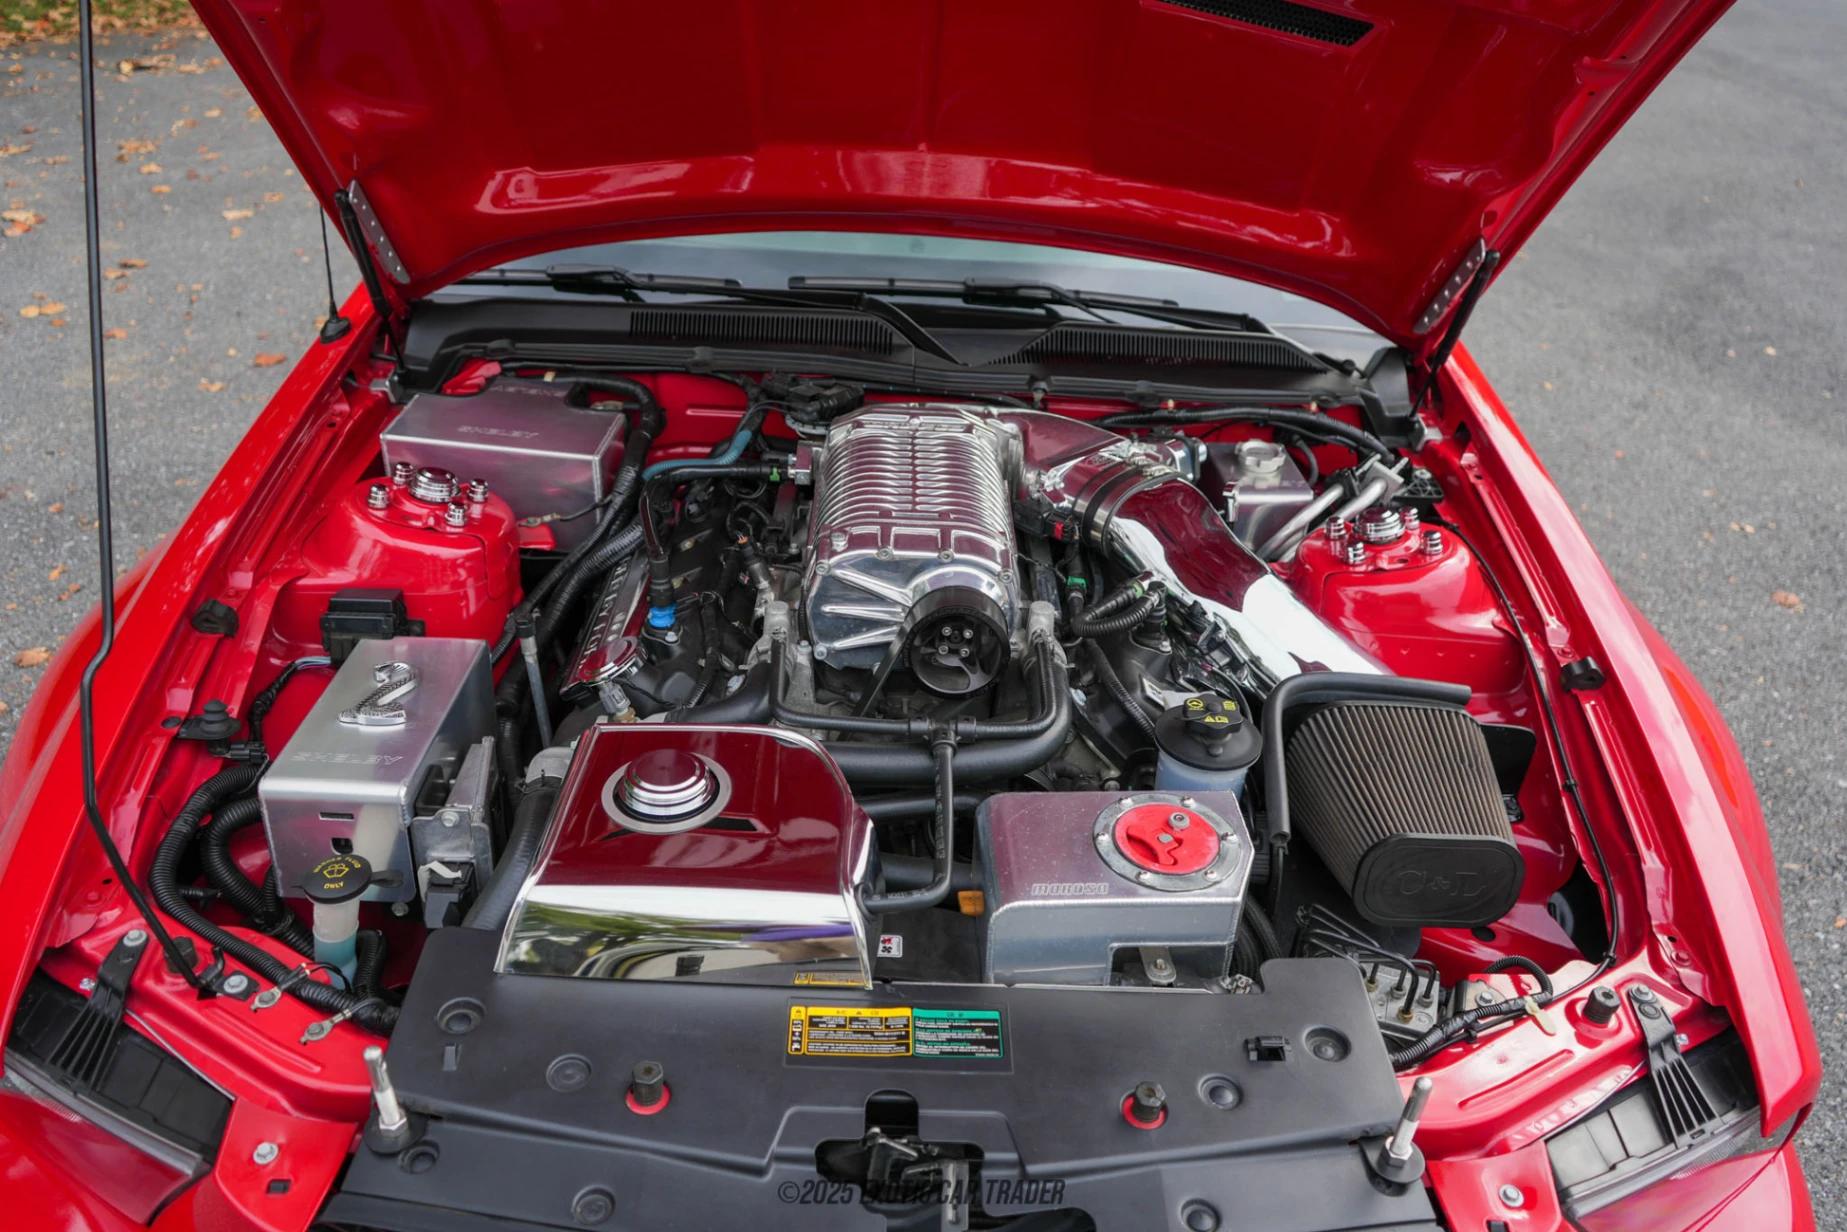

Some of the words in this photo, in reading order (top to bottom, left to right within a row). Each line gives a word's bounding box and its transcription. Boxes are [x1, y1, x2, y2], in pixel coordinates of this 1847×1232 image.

[291, 751, 404, 765] SHELBY
[345, 856, 362, 869] FLUID
[323, 881, 345, 889] ONLY
[1031, 883, 1109, 896] MOROSO
